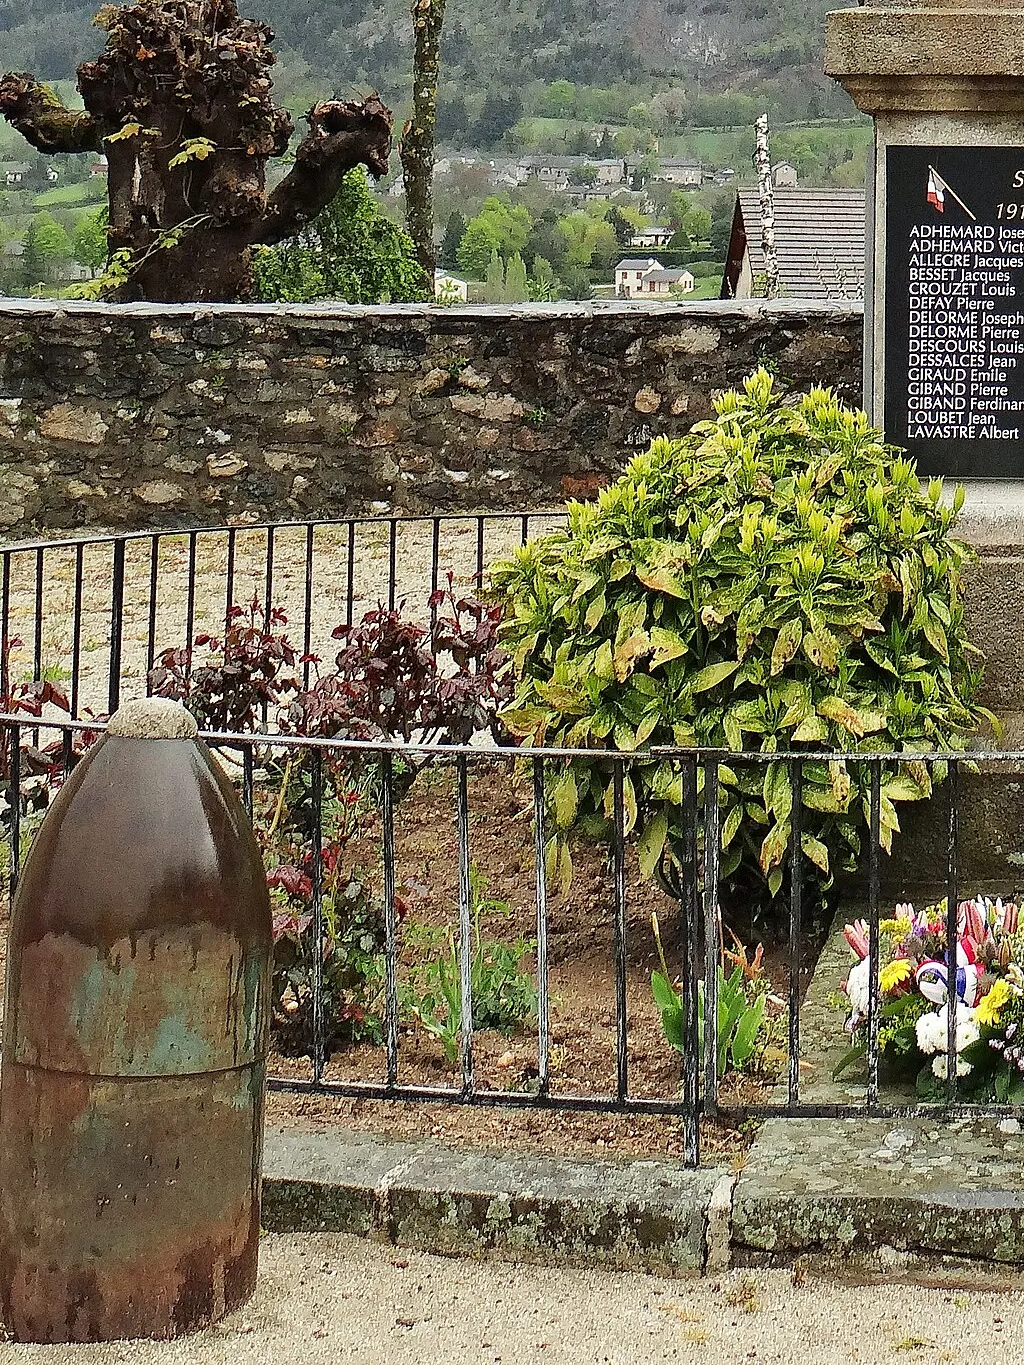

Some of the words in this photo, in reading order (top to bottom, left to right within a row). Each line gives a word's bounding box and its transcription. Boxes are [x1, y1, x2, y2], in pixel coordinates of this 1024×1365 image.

[909, 225, 994, 237] ADHEMARD
[909, 240, 994, 252] ADHEMARD
[909, 254, 970, 266] ALLEGRE
[974, 256, 1023, 270] Jacques
[909, 268, 956, 280] BESSET
[960, 269, 1010, 284] Jacques
[909, 283, 977, 295] CROUZET
[982, 283, 1016, 296] Louis
[909, 297, 953, 309] DEFAY
[957, 298, 994, 310] Pierre
[909, 311, 977, 324] DELORME
[981, 312, 1024, 326] Joseph
[909, 326, 977, 338] DELORME
[982, 326, 1019, 339] Pierre
[909, 340, 985, 352] DESCOURS
[991, 341, 1024, 353] Louis
[909, 354, 985, 367] DESSALCES
[988, 356, 1016, 369] Jean
[908, 368, 966, 381] GIRAUD
[971, 369, 1006, 381] Emile
[908, 383, 966, 395] GIBAND
[971, 383, 1008, 395] Pierre
[908, 397, 966, 409] GIBAND
[908, 411, 964, 424] LOUBET
[968, 412, 996, 426] Jean
[908, 426, 975, 438] LAVASTRE
[979, 427, 1019, 439] Albert
